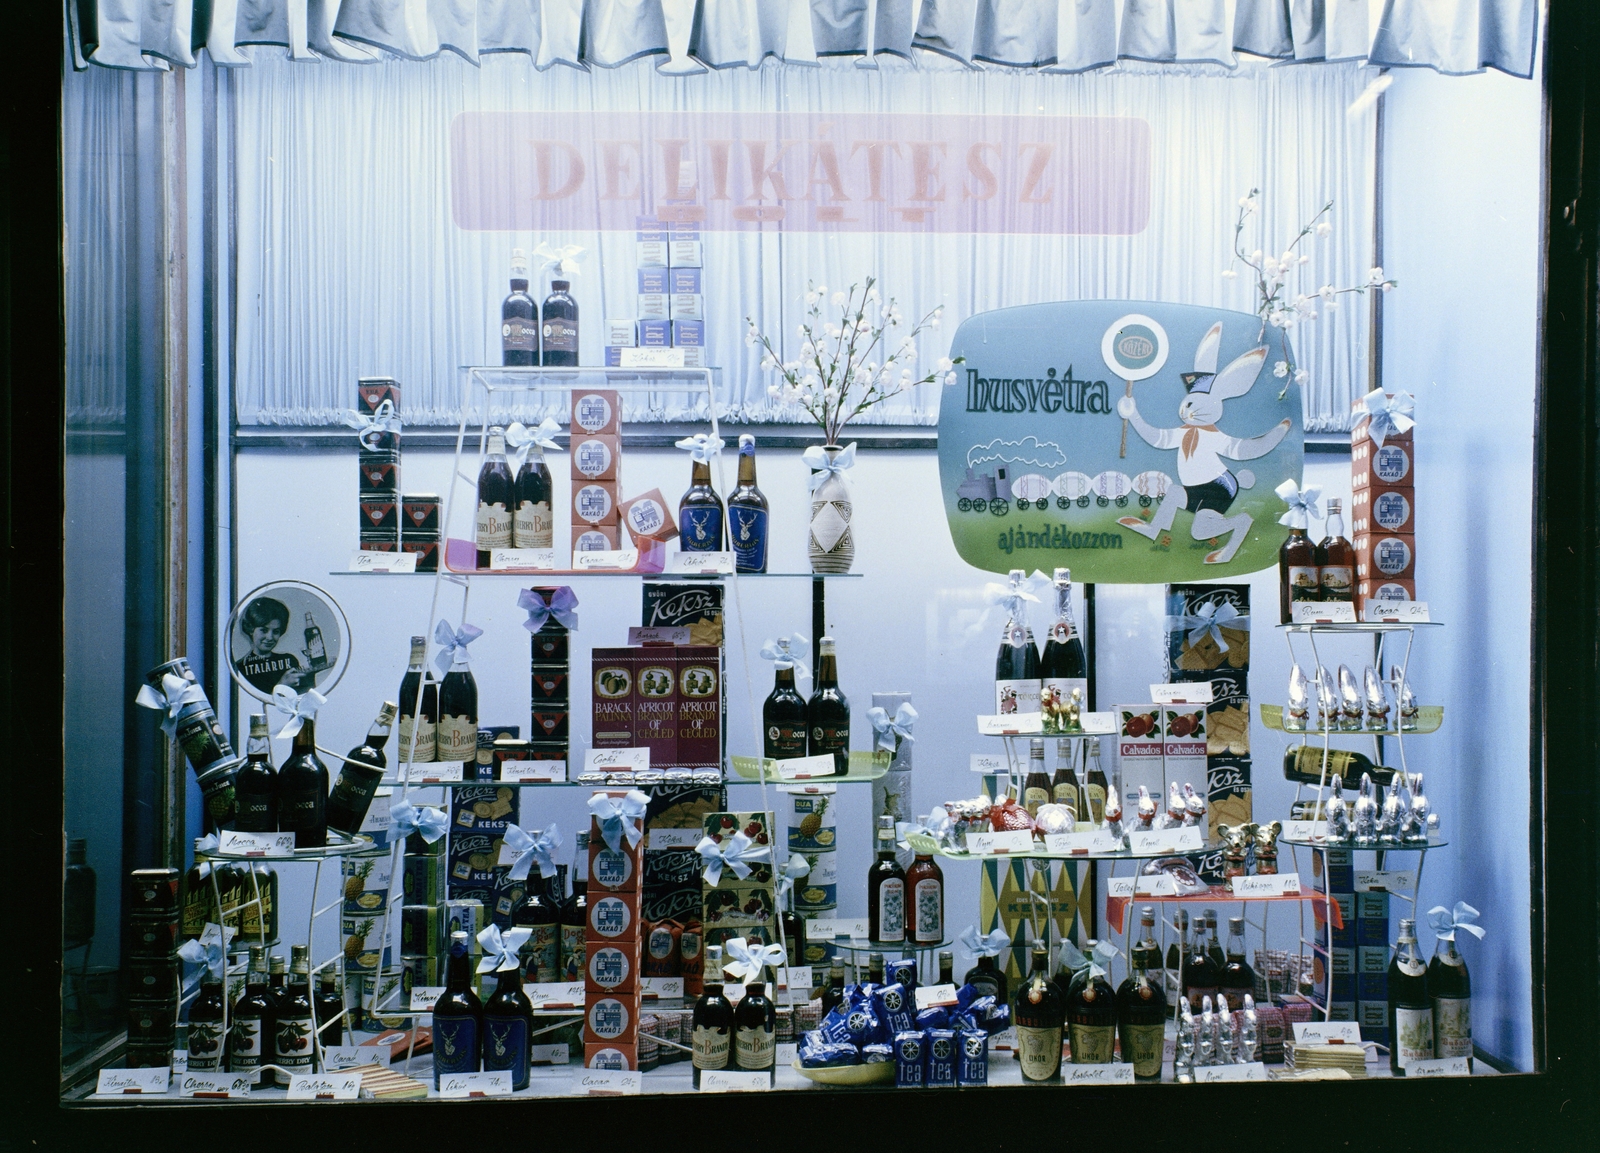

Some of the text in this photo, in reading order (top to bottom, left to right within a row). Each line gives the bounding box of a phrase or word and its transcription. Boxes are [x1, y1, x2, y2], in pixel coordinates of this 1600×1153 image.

[527, 124, 1056, 204] DELIKÁTESZ
[998, 524, 1123, 554] ajándékozzon
[650, 590, 715, 628] Keksz
[244, 658, 292, 676] ITALÁRUK
[595, 703, 632, 714] BARACK
[637, 702, 675, 713] APRICOT
[679, 701, 717, 713] APRICOT
[649, 719, 662, 730] OF
[691, 719, 704, 730] OF
[1122, 744, 1161, 755] Calvados
[1166, 744, 1205, 755] Calvados
[658, 872, 689, 883] KEKSZ
[899, 1062, 922, 1082] tea
[930, 1060, 951, 1081] tea
[963, 1059, 985, 1080] tea
[184, 1077, 215, 1090] Cherry
[296, 1079, 333, 1092] Balaton
